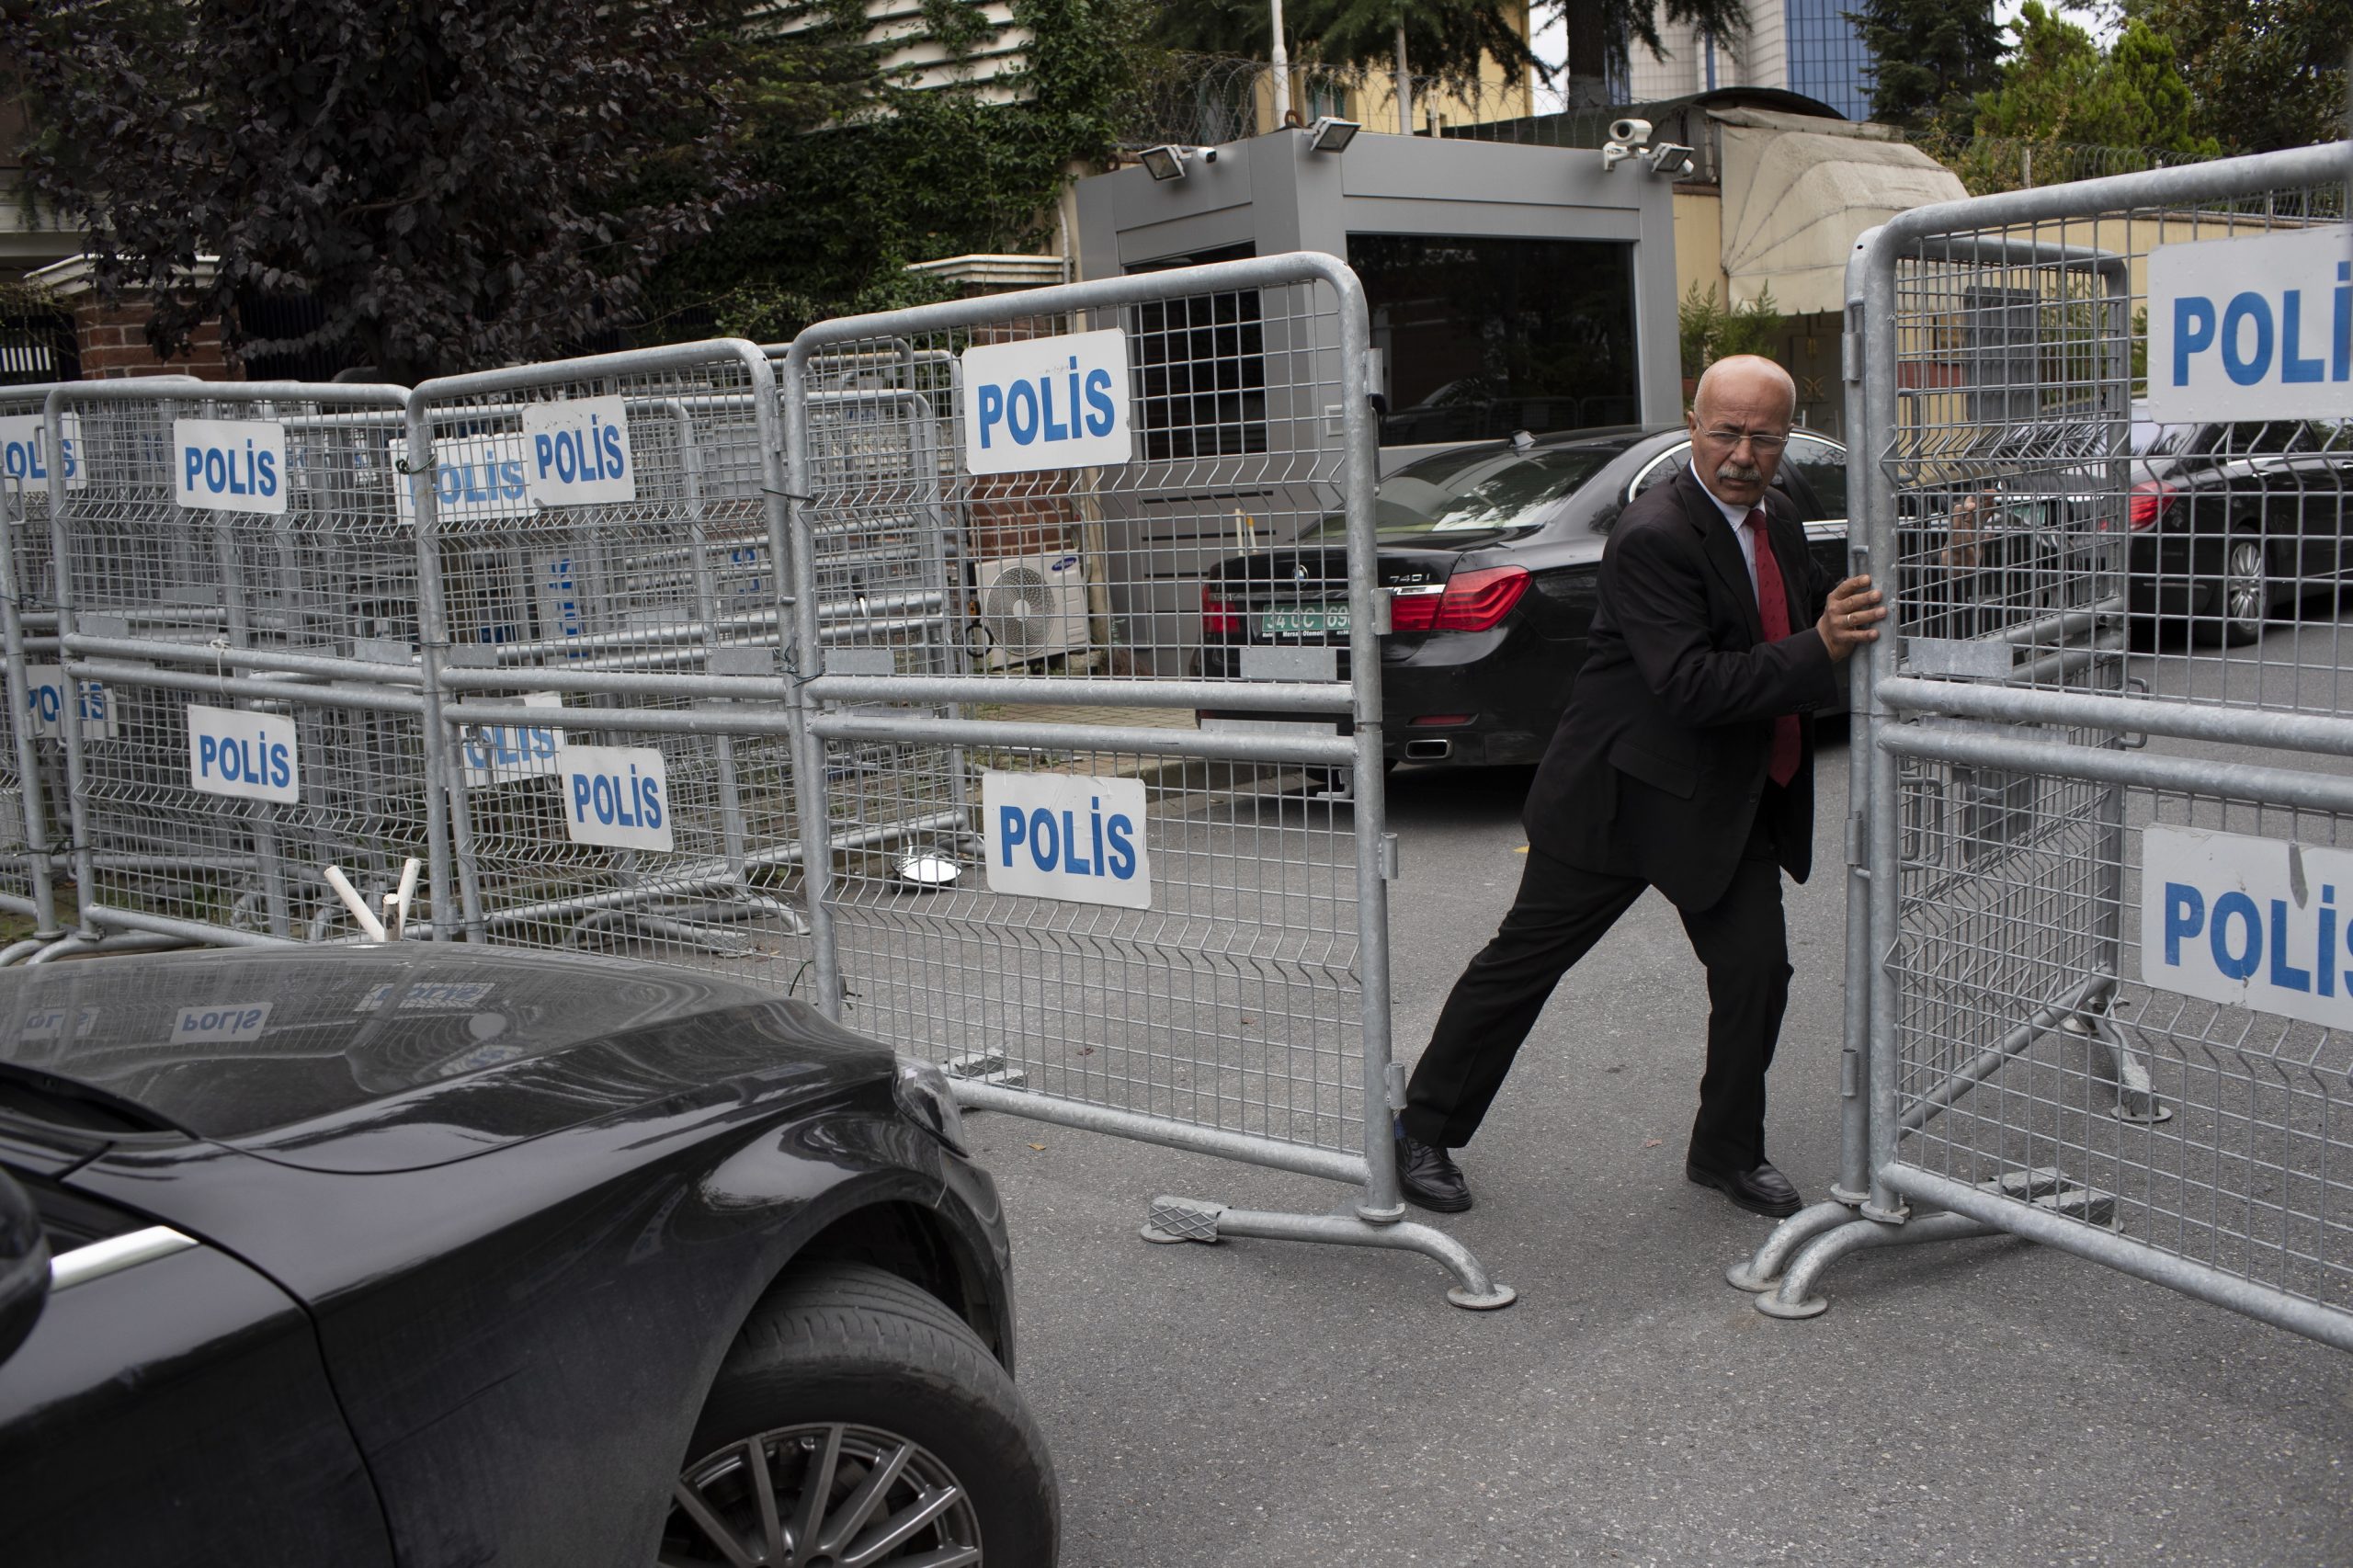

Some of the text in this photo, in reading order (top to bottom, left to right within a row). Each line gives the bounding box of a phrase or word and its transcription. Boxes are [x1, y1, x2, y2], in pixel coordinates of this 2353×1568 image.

[2173, 260, 2353, 387] POLİ
[978, 356, 1115, 449] POLİS
[5, 438, 75, 479] OLS
[185, 438, 277, 497] POLİS
[409, 449, 525, 507] OLİS
[534, 414, 624, 483] POLİS
[1326, 605, 1350, 627] 69
[199, 731, 290, 788] POLİS
[573, 764, 662, 829] POLİS
[1000, 796, 1136, 881] POLİS
